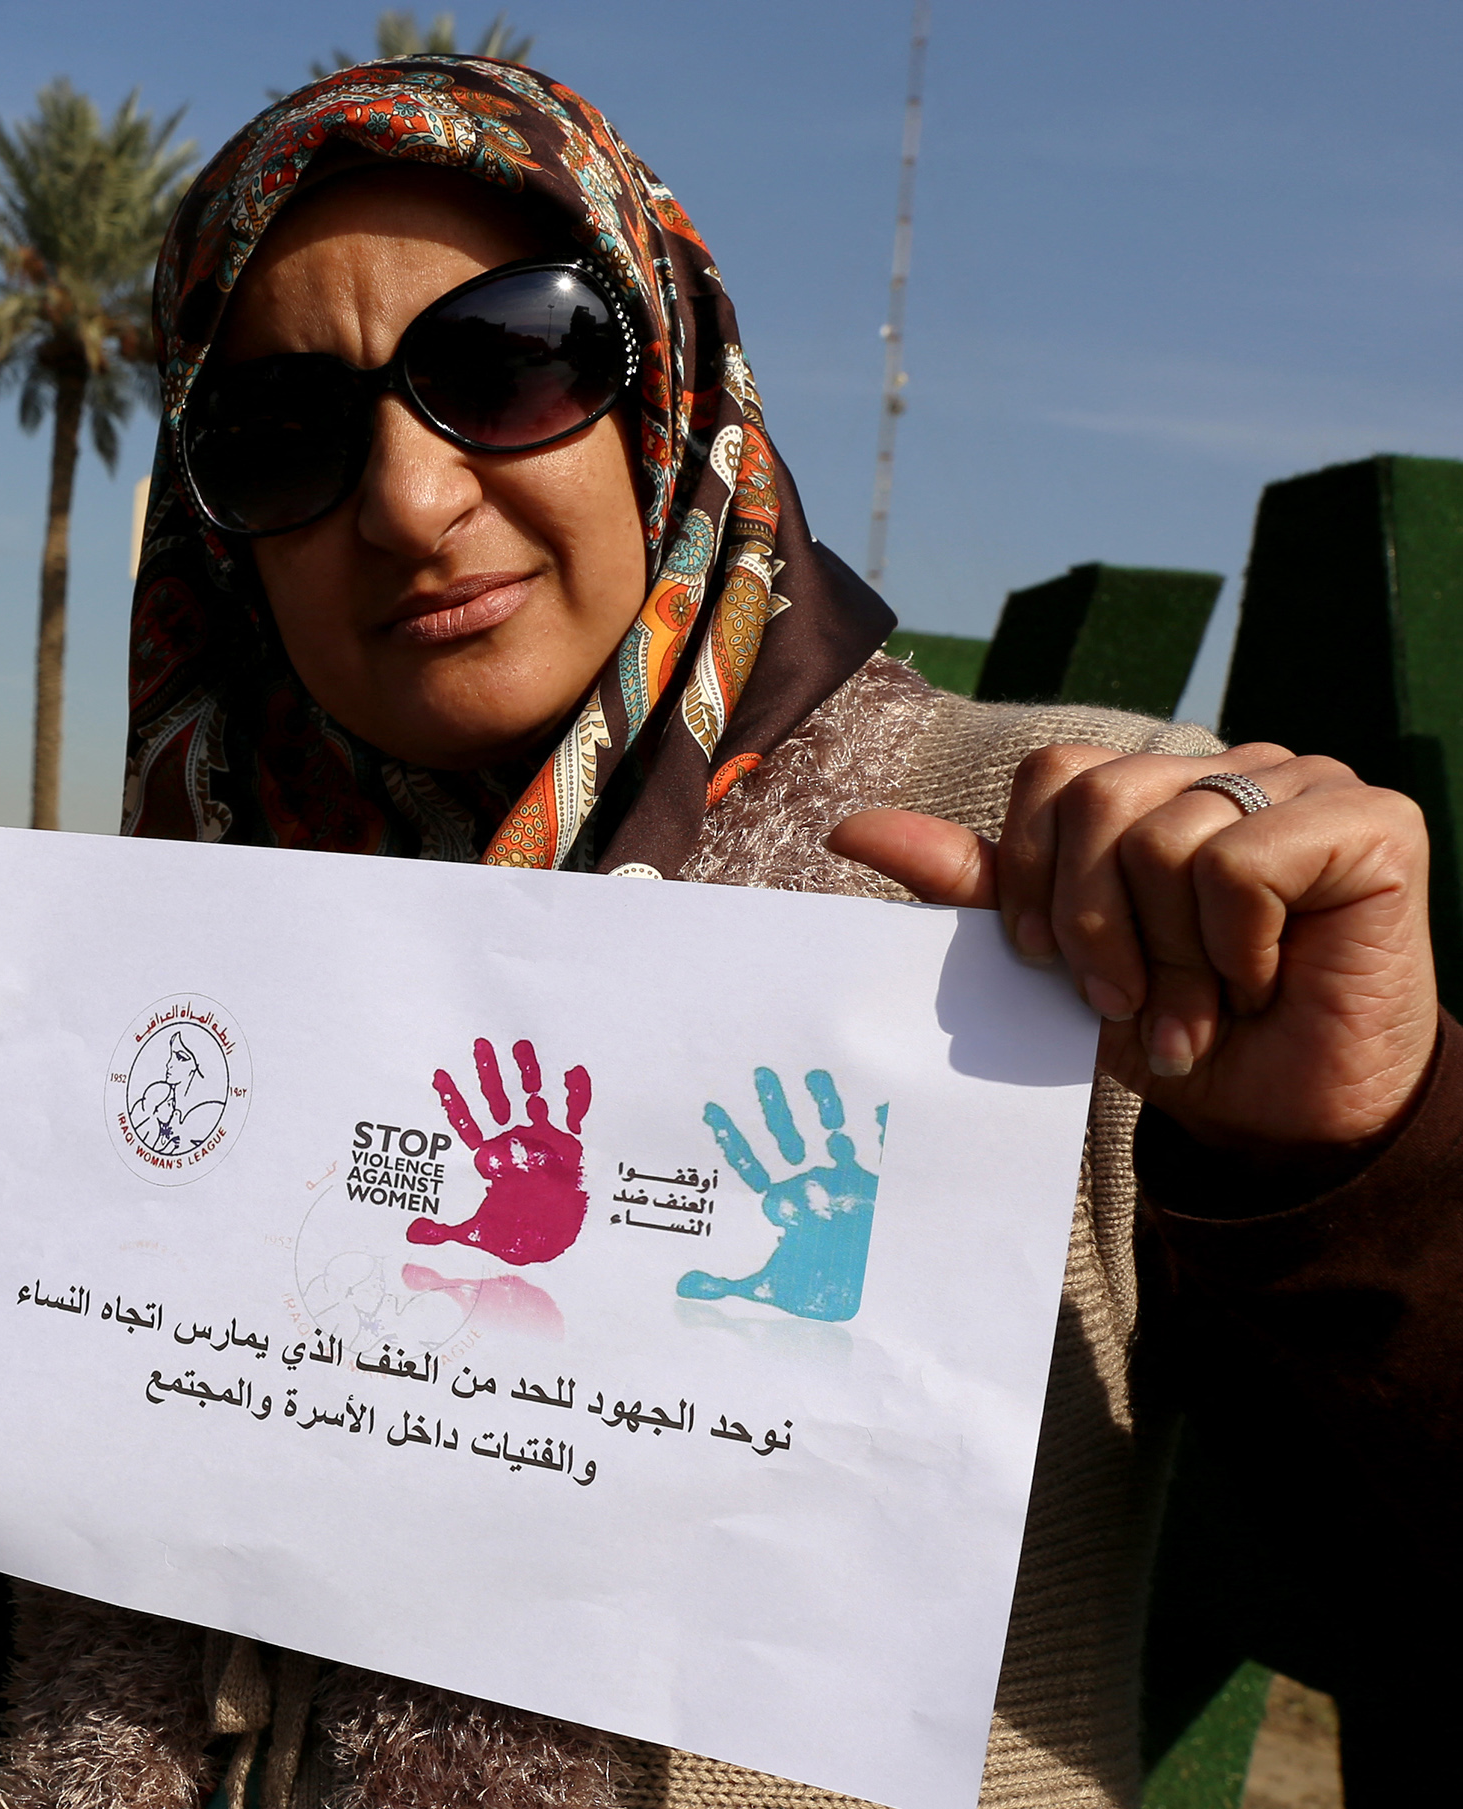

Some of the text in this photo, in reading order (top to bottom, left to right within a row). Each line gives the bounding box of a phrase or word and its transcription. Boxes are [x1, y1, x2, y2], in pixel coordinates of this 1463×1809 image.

[110, 1072, 127, 1084] 1952
[117, 1112, 227, 1170] IRAQI WOMAN'S LEAGUE
[352, 1121, 452, 1160] STOP
[346, 1166, 444, 1195] AGAINST
[351, 1150, 445, 1179] VIOLENCE
[346, 1182, 440, 1215] WOMEN
[612, 1189, 714, 1215] العنف ضد
[609, 1209, 712, 1237] النساء
[16, 1279, 91, 1317] النساء
[100, 1295, 164, 1334] اتجاه
[173, 1318, 269, 1360] يمارس
[281, 1328, 343, 1371] الذي
[356, 1343, 439, 1384] العنف
[451, 1366, 497, 1400] من
[510, 1376, 576, 1409] للحد
[145, 1369, 598, 1487] والفتيات داخل الأسرة والمجتمع
[587, 1391, 696, 1436] الجهود
[710, 1414, 794, 1456] نوحد
